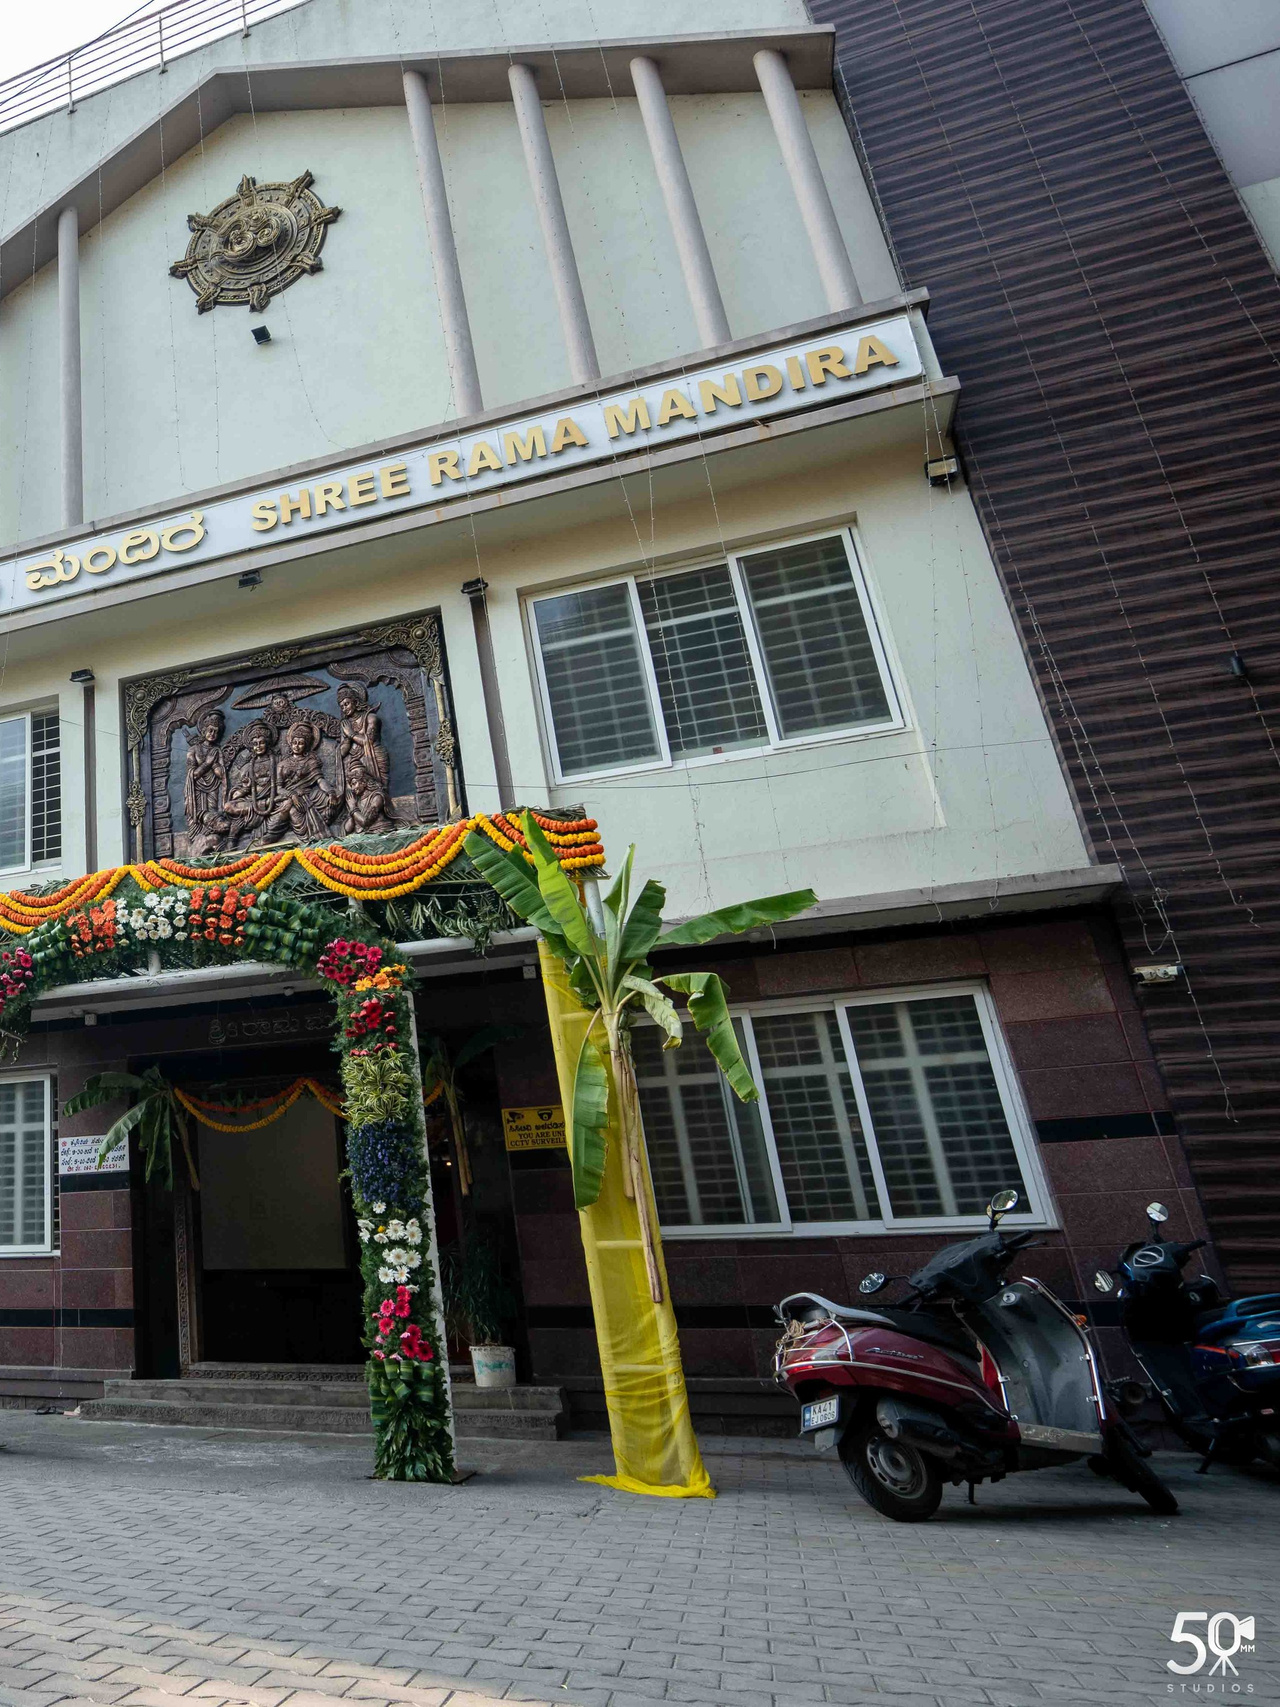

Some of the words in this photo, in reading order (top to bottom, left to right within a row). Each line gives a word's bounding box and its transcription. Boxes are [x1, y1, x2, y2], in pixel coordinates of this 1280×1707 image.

[251, 463, 411, 532] SHREE
[428, 417, 589, 486] RAMA
[603, 335, 900, 439] MANDIRA
[26, 511, 207, 591] ಮಂದಿರ
[510, 1139, 531, 1147] CCTV
[518, 1132, 533, 1140] YOU
[535, 1131, 551, 1139] ARE
